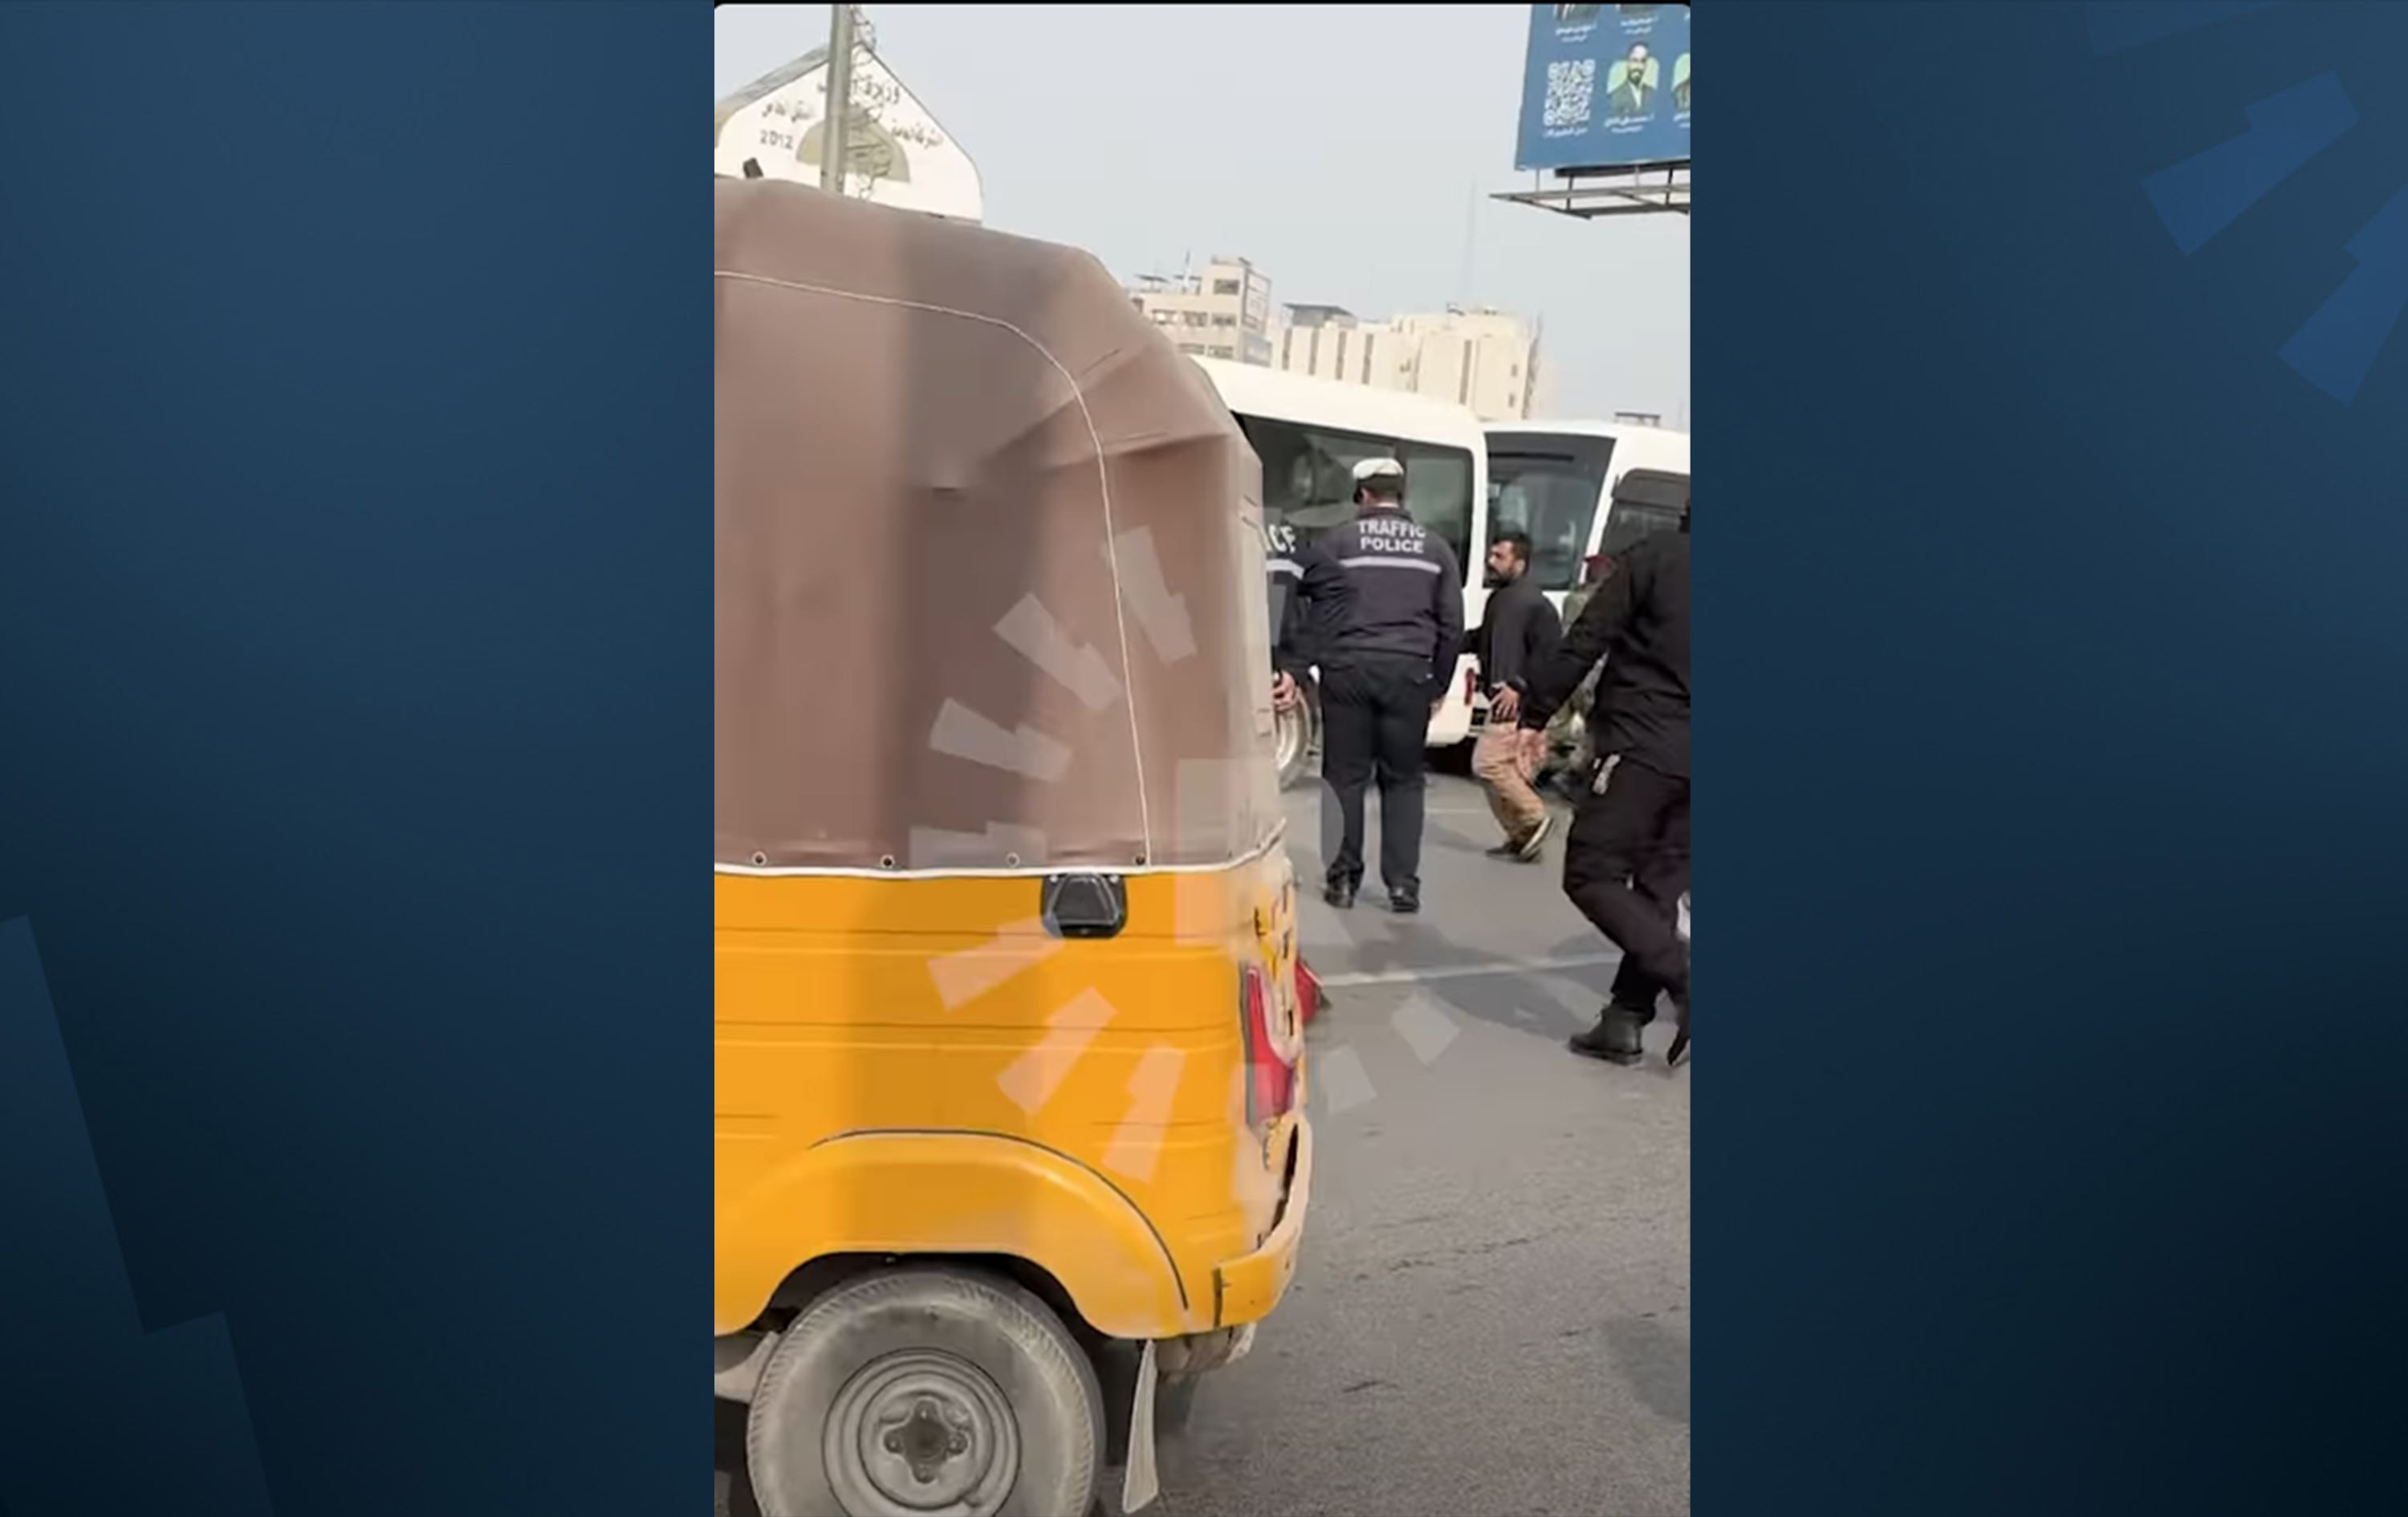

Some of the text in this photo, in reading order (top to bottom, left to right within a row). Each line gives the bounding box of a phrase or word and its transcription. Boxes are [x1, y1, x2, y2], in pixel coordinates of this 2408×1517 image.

[759, 129, 793, 149] 2012
[1359, 519, 1426, 538] TRAFFIC
[1360, 535, 1425, 554] POLICE
